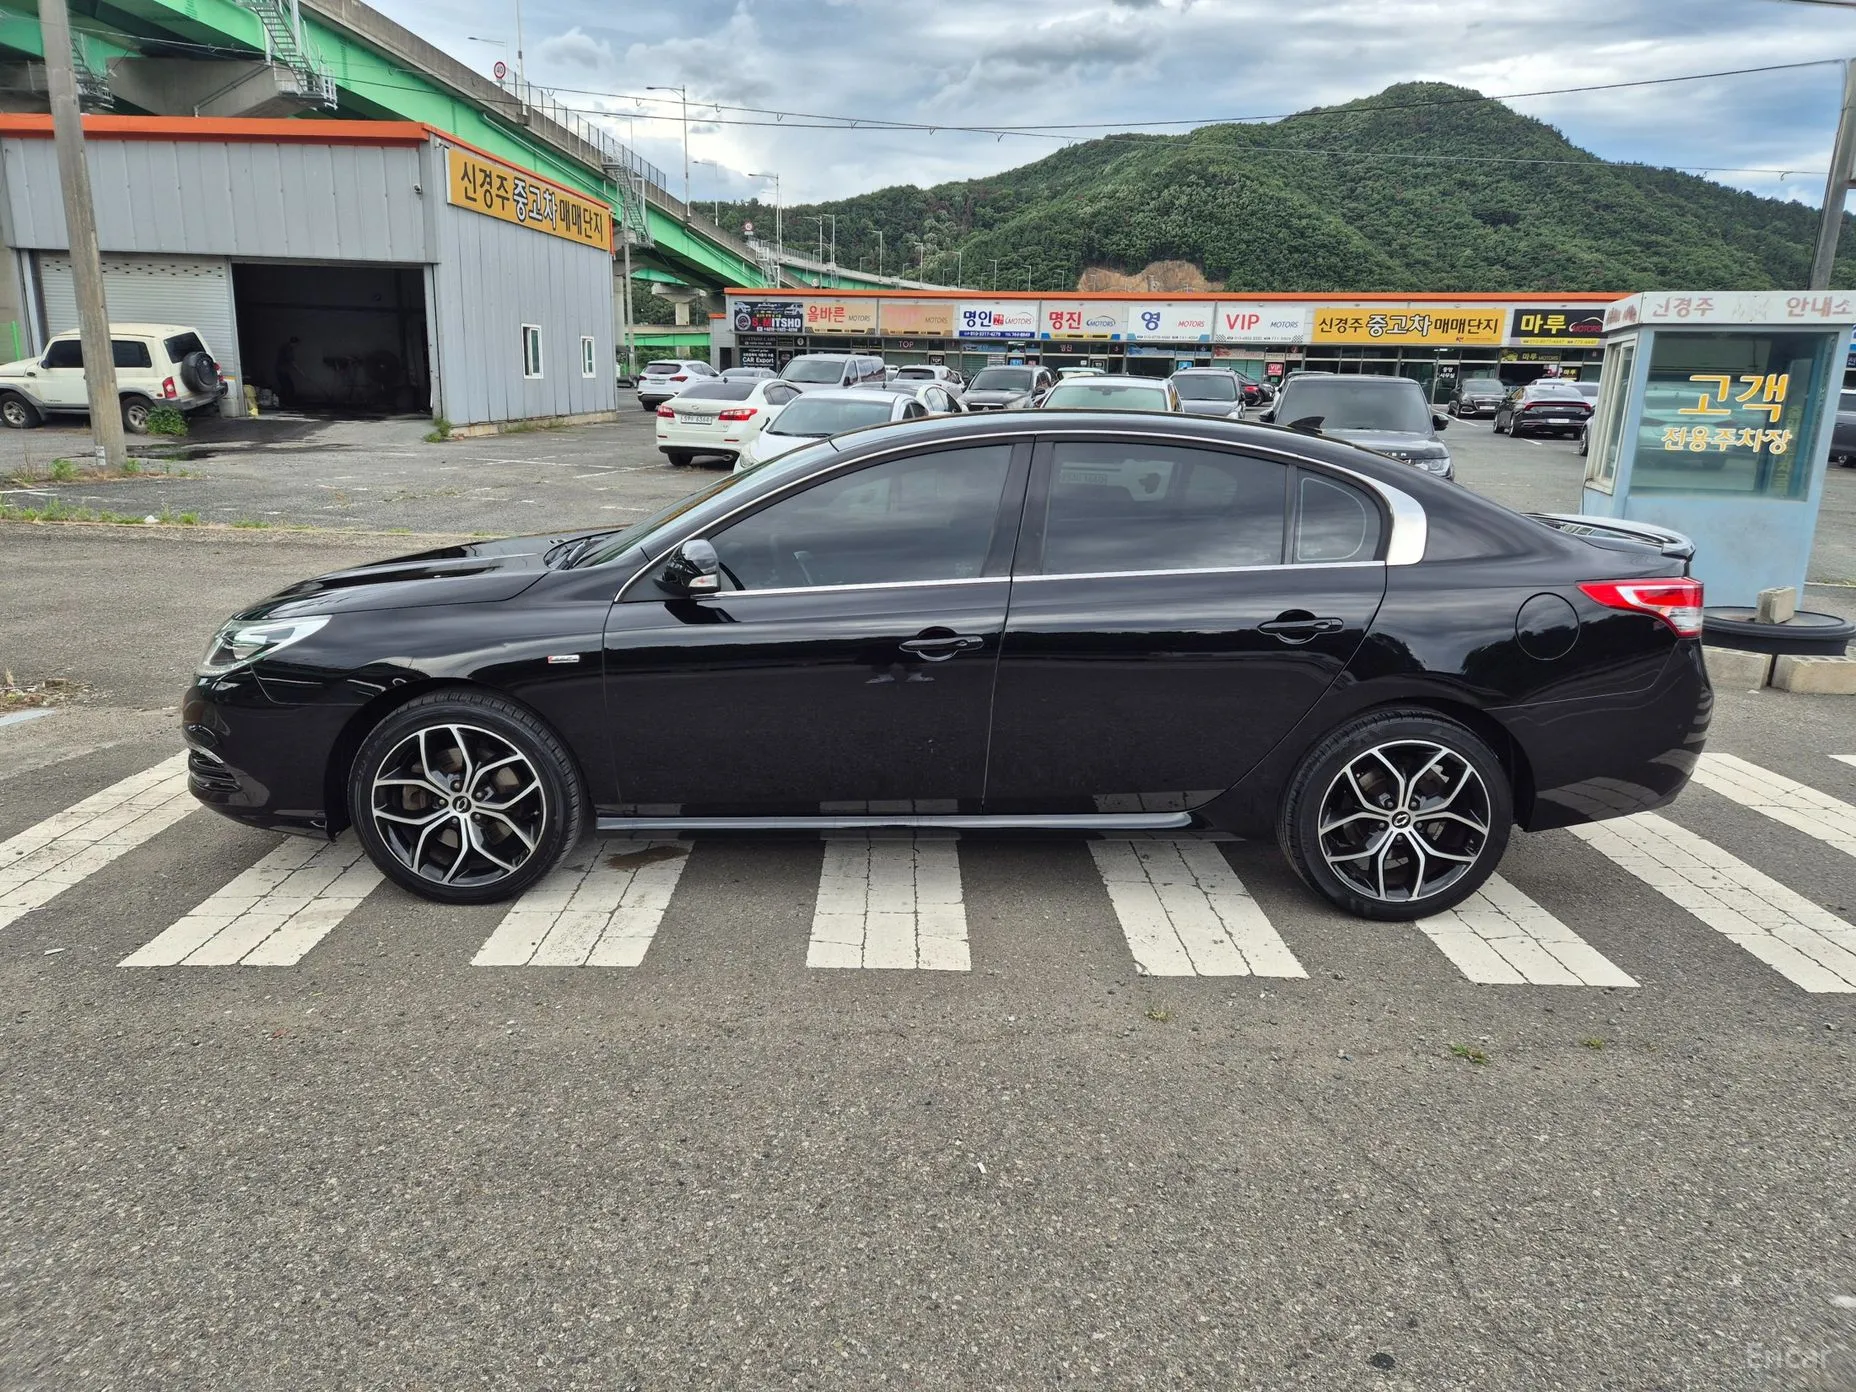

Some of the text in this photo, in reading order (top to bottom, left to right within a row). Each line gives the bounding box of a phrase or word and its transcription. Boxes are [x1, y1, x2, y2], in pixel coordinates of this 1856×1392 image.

[460, 161, 603, 242] 신경주 중고차 매매단지
[807, 305, 845, 322] 올바른
[1652, 296, 1714, 317] 신경주
[1786, 296, 1851, 317] 안내소
[963, 310, 992, 328] 명인
[1008, 317, 1032, 325] MOTORS
[1049, 311, 1082, 330] 명진
[1141, 311, 1161, 331] 영
[1178, 320, 1205, 328] MOTORS
[1226, 313, 1260, 331] VIP
[1270, 321, 1299, 329] MOTORS
[1319, 313, 1499, 337] 신경주 중고차 매매단지
[1520, 313, 1566, 335] 마루
[1571, 325, 1604, 333] MOTORS
[899, 340, 914, 348] TOP
[1678, 373, 1789, 423] 고객
[1661, 426, 1793, 455] 전용주차장
